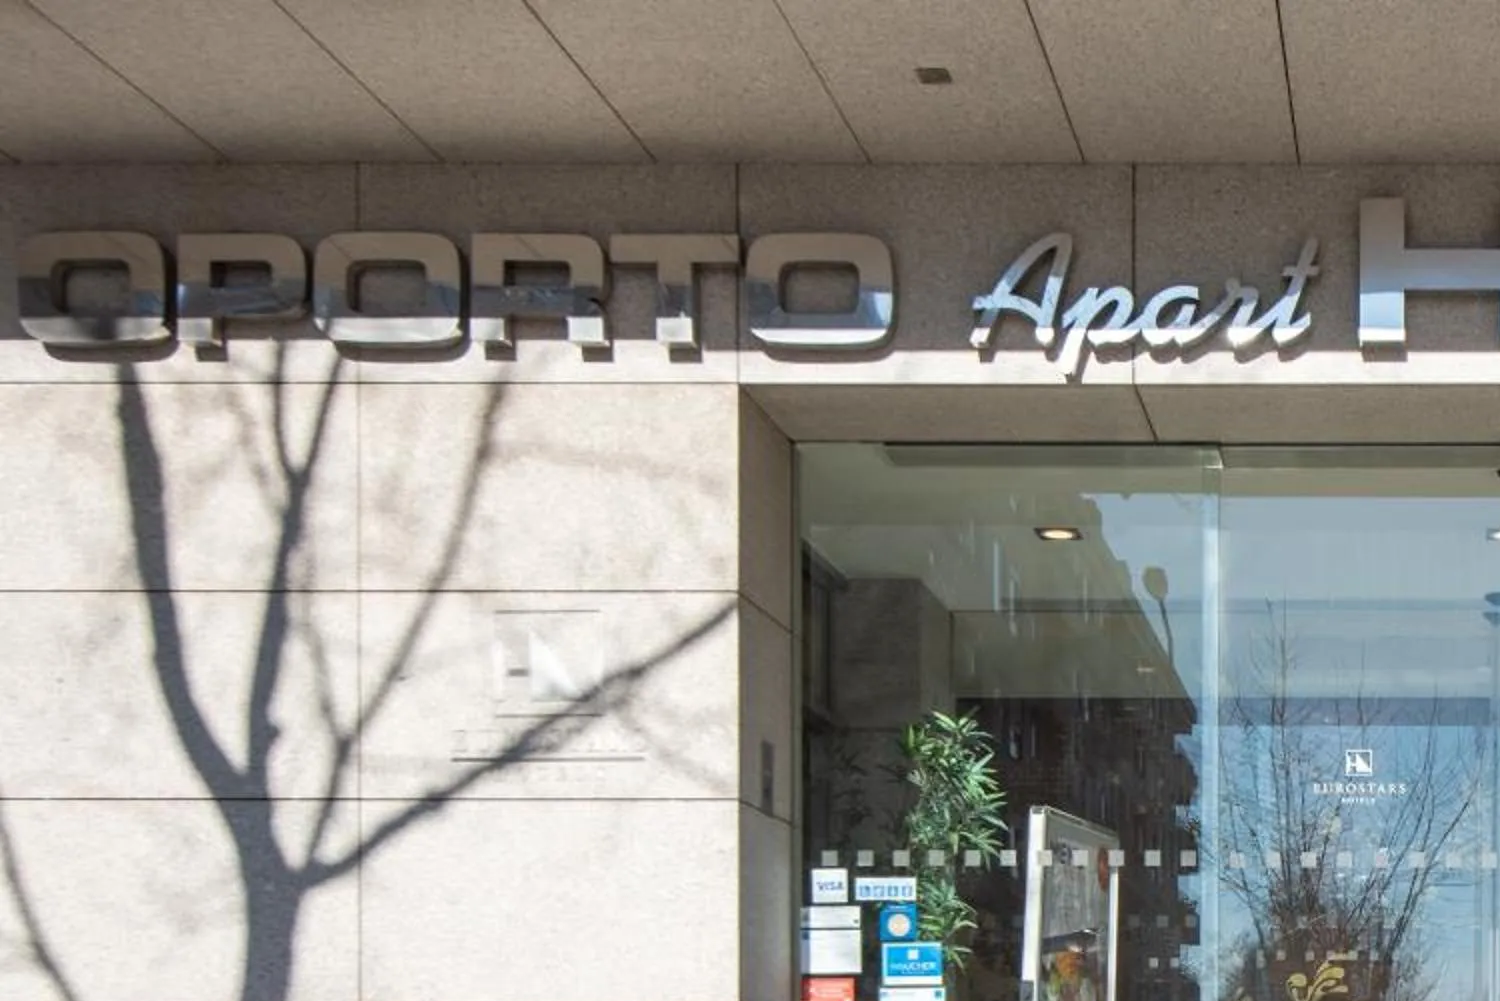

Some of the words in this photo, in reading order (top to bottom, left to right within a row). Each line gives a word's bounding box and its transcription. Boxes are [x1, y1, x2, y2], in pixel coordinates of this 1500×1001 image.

[18, 231, 897, 346] OPORTO
[972, 232, 1321, 375] Apart
[1313, 783, 1406, 795] EUROSTARS
[816, 880, 844, 892] VISA
